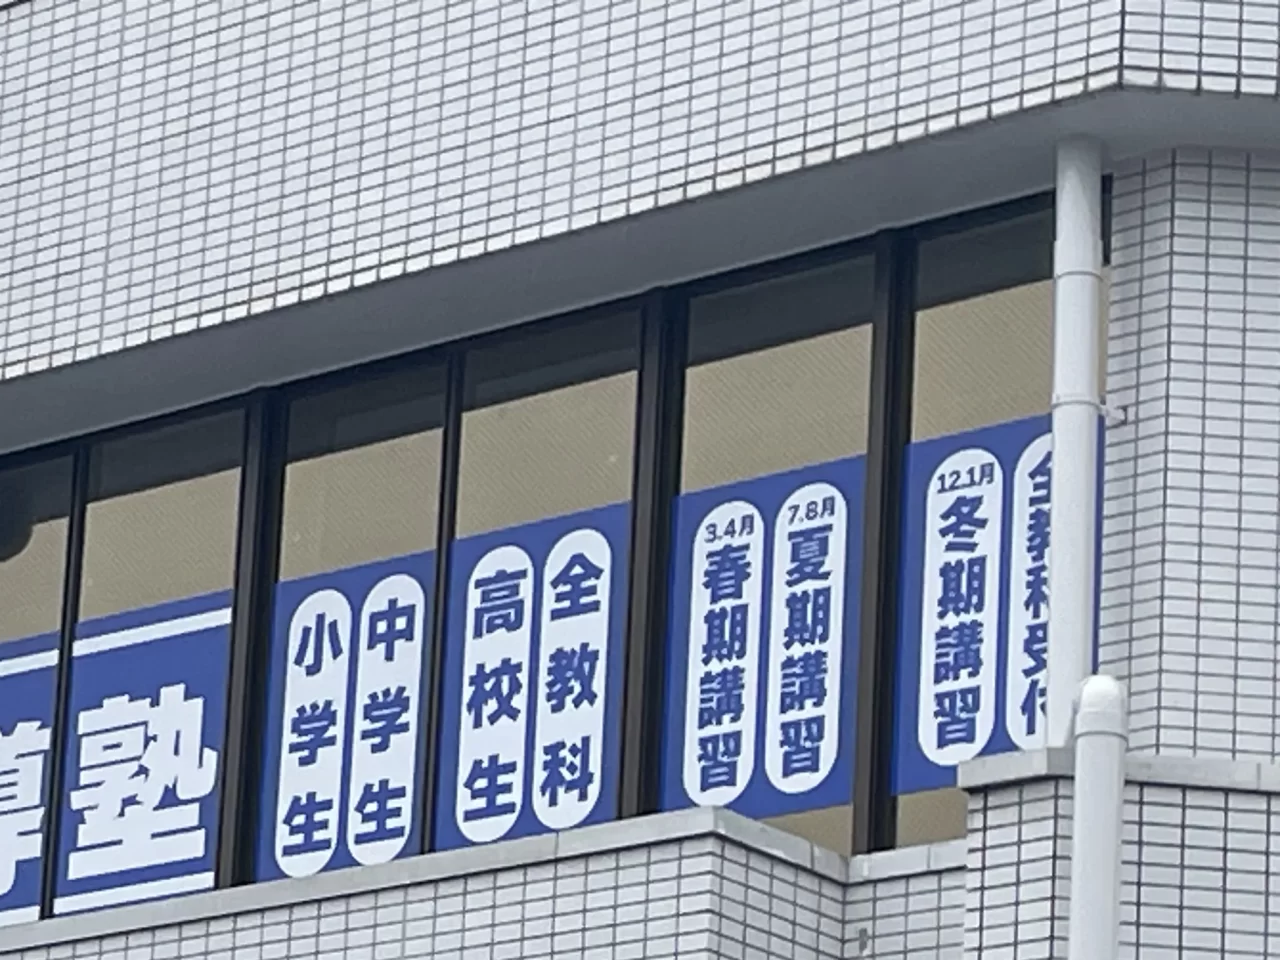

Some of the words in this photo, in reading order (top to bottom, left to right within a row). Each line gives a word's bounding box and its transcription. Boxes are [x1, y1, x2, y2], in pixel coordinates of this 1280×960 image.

[281, 612, 344, 858] 小学生
[354, 597, 417, 846] 中学生
[463, 568, 528, 823] 高校生
[540, 552, 605, 808] 全教科
[697, 543, 752, 793] 春期講習
[778, 523, 834, 780] 夏期講習
[933, 495, 988, 750] 冬期講習
